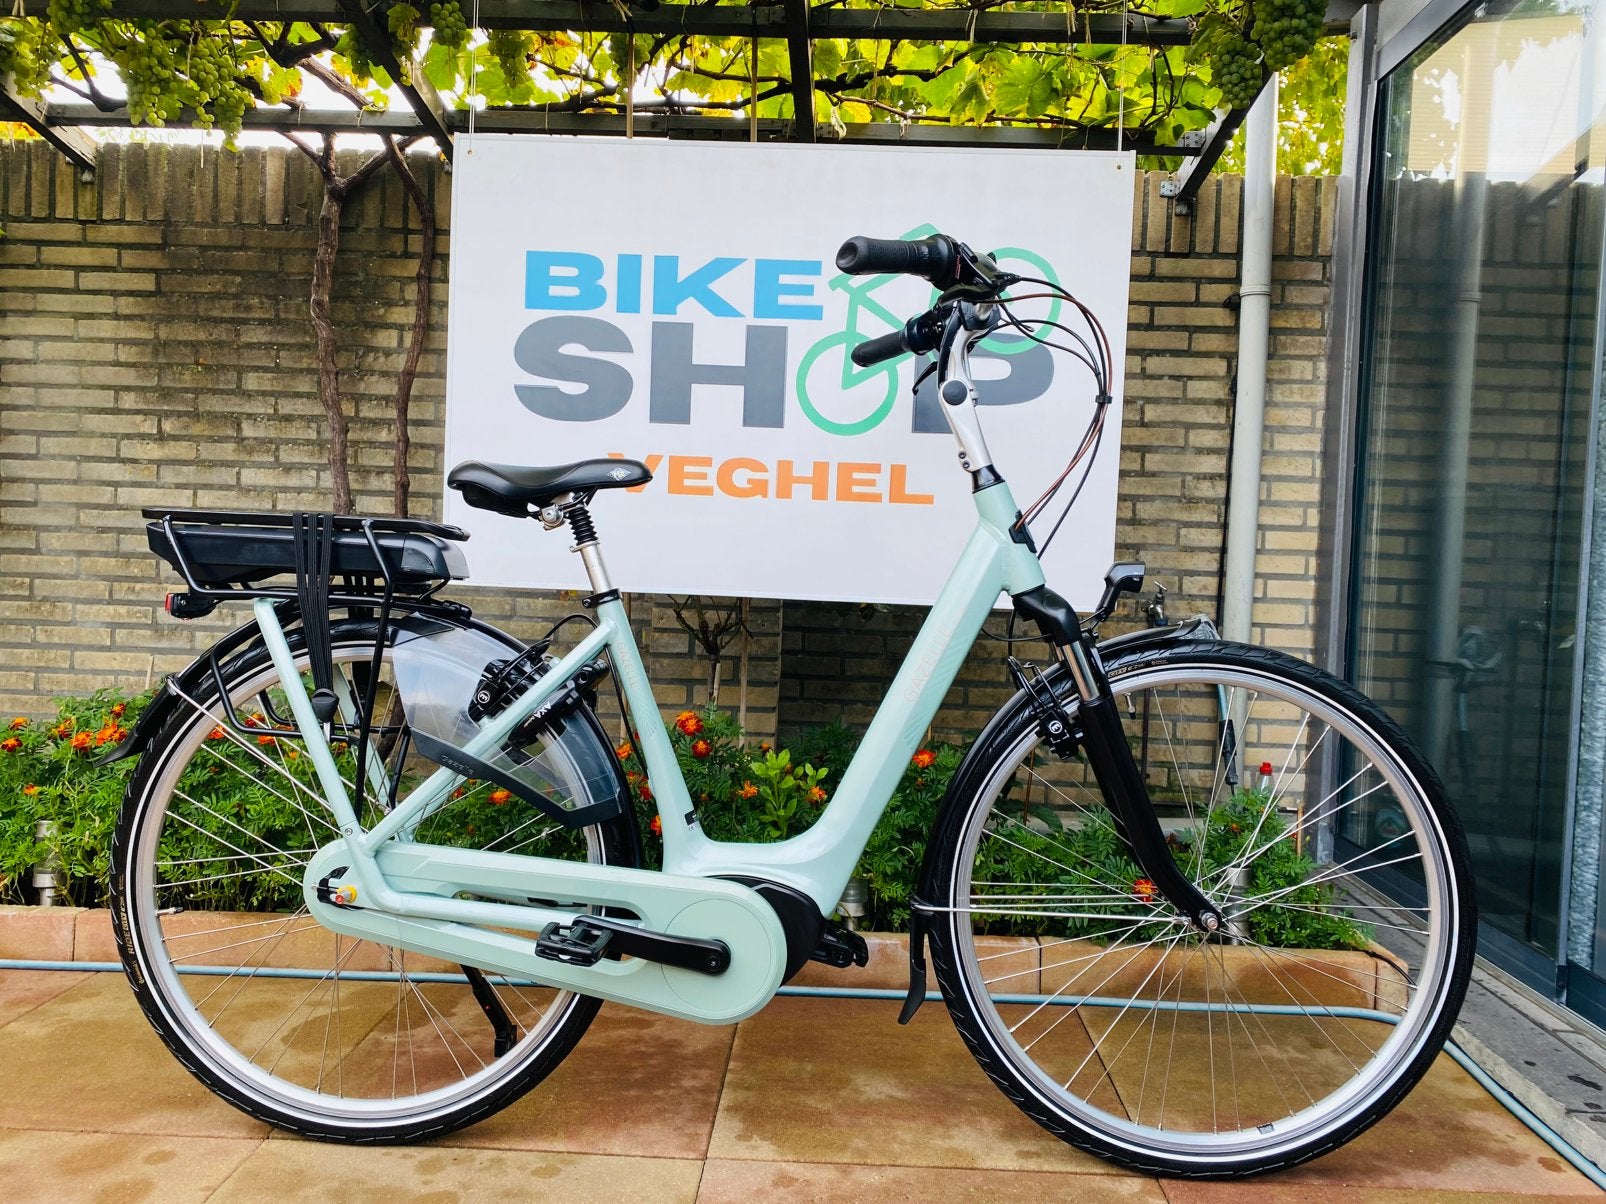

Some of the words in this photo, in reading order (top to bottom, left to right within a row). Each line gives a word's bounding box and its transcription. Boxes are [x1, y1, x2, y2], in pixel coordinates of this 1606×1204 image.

[524, 250, 823, 320] BIKE
[533, 701, 552, 719] AXA
[124, 931, 135, 955] RIDE
